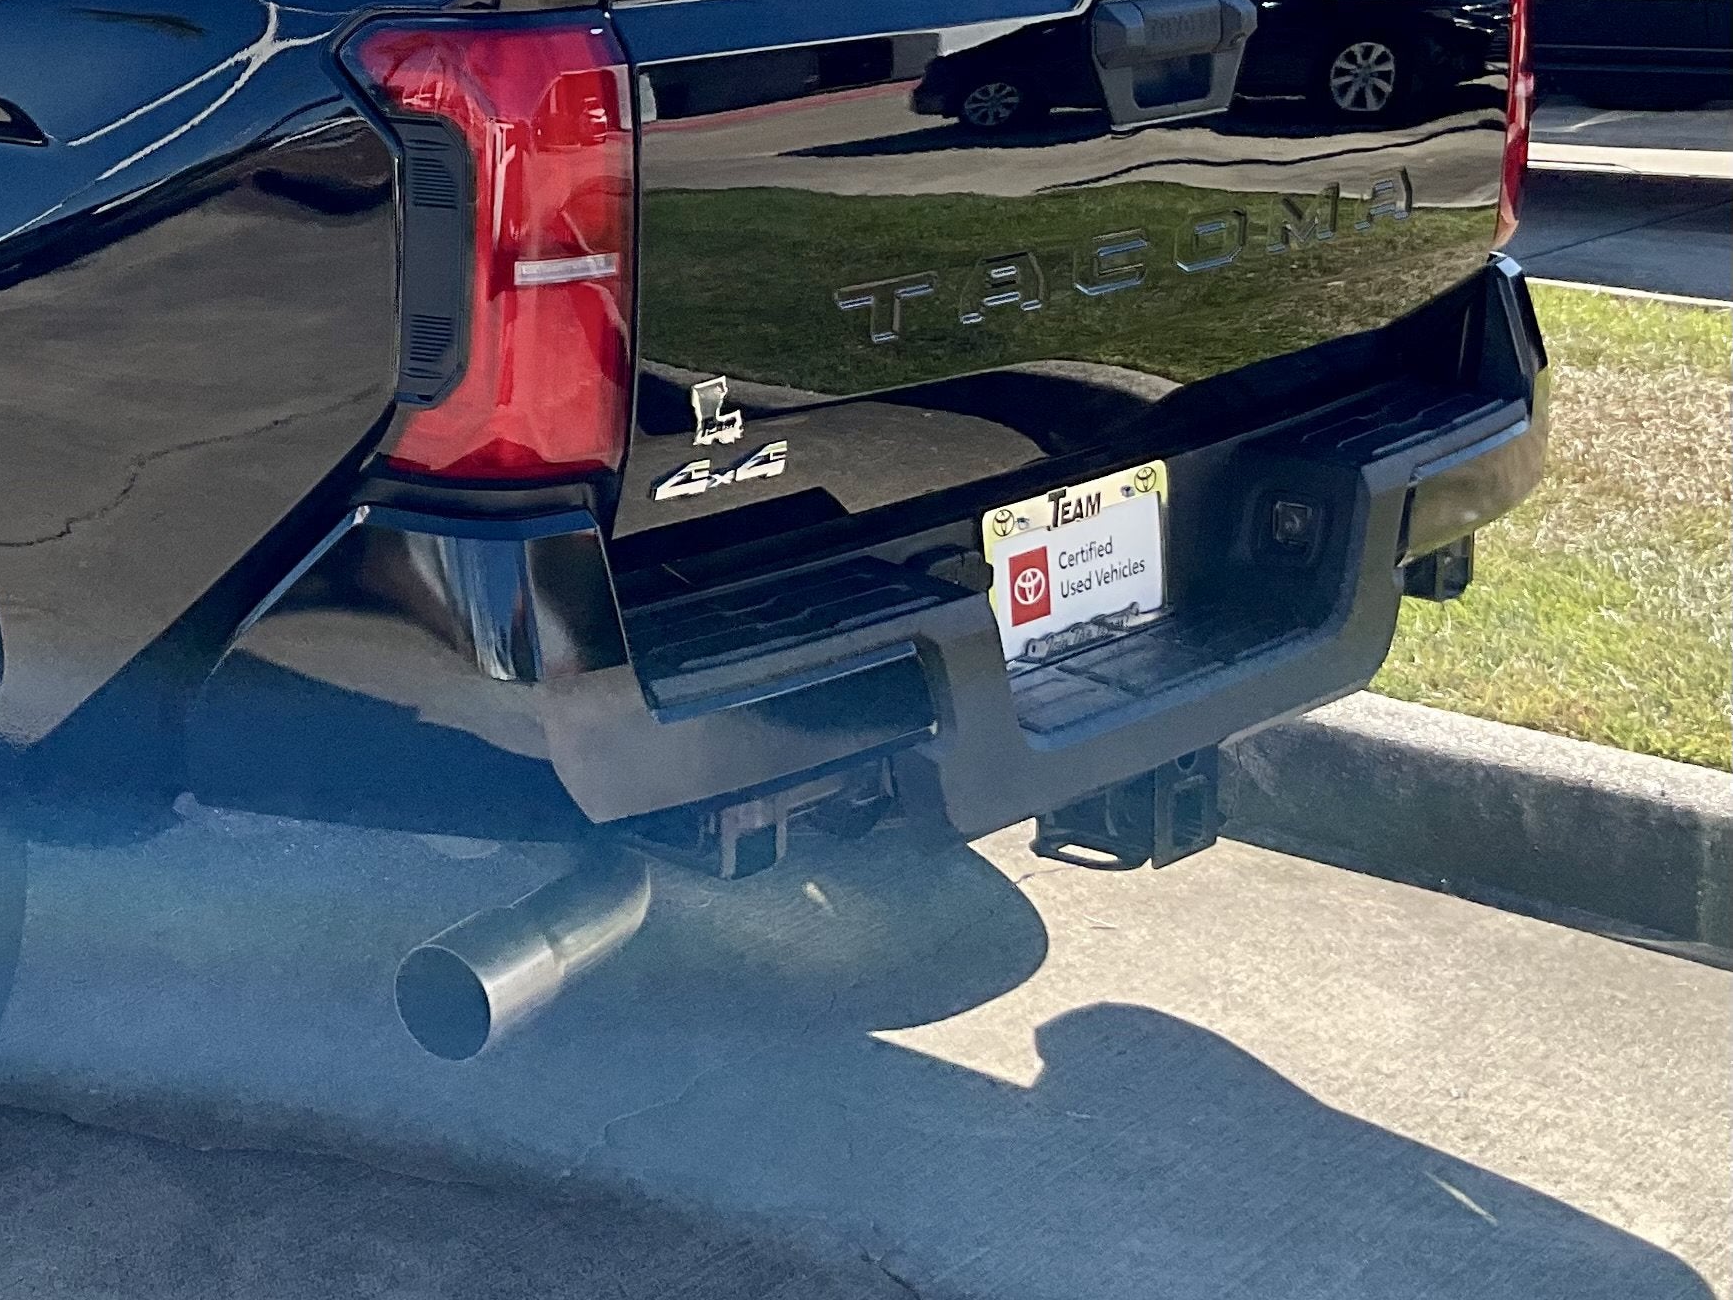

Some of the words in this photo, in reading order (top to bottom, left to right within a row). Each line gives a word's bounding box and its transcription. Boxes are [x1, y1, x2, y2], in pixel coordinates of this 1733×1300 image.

[834, 166, 1412, 343] TACOMA
[1058, 535, 1114, 570] Certified
[1060, 570, 1092, 599] Used
[1095, 557, 1146, 587] Vehicles
